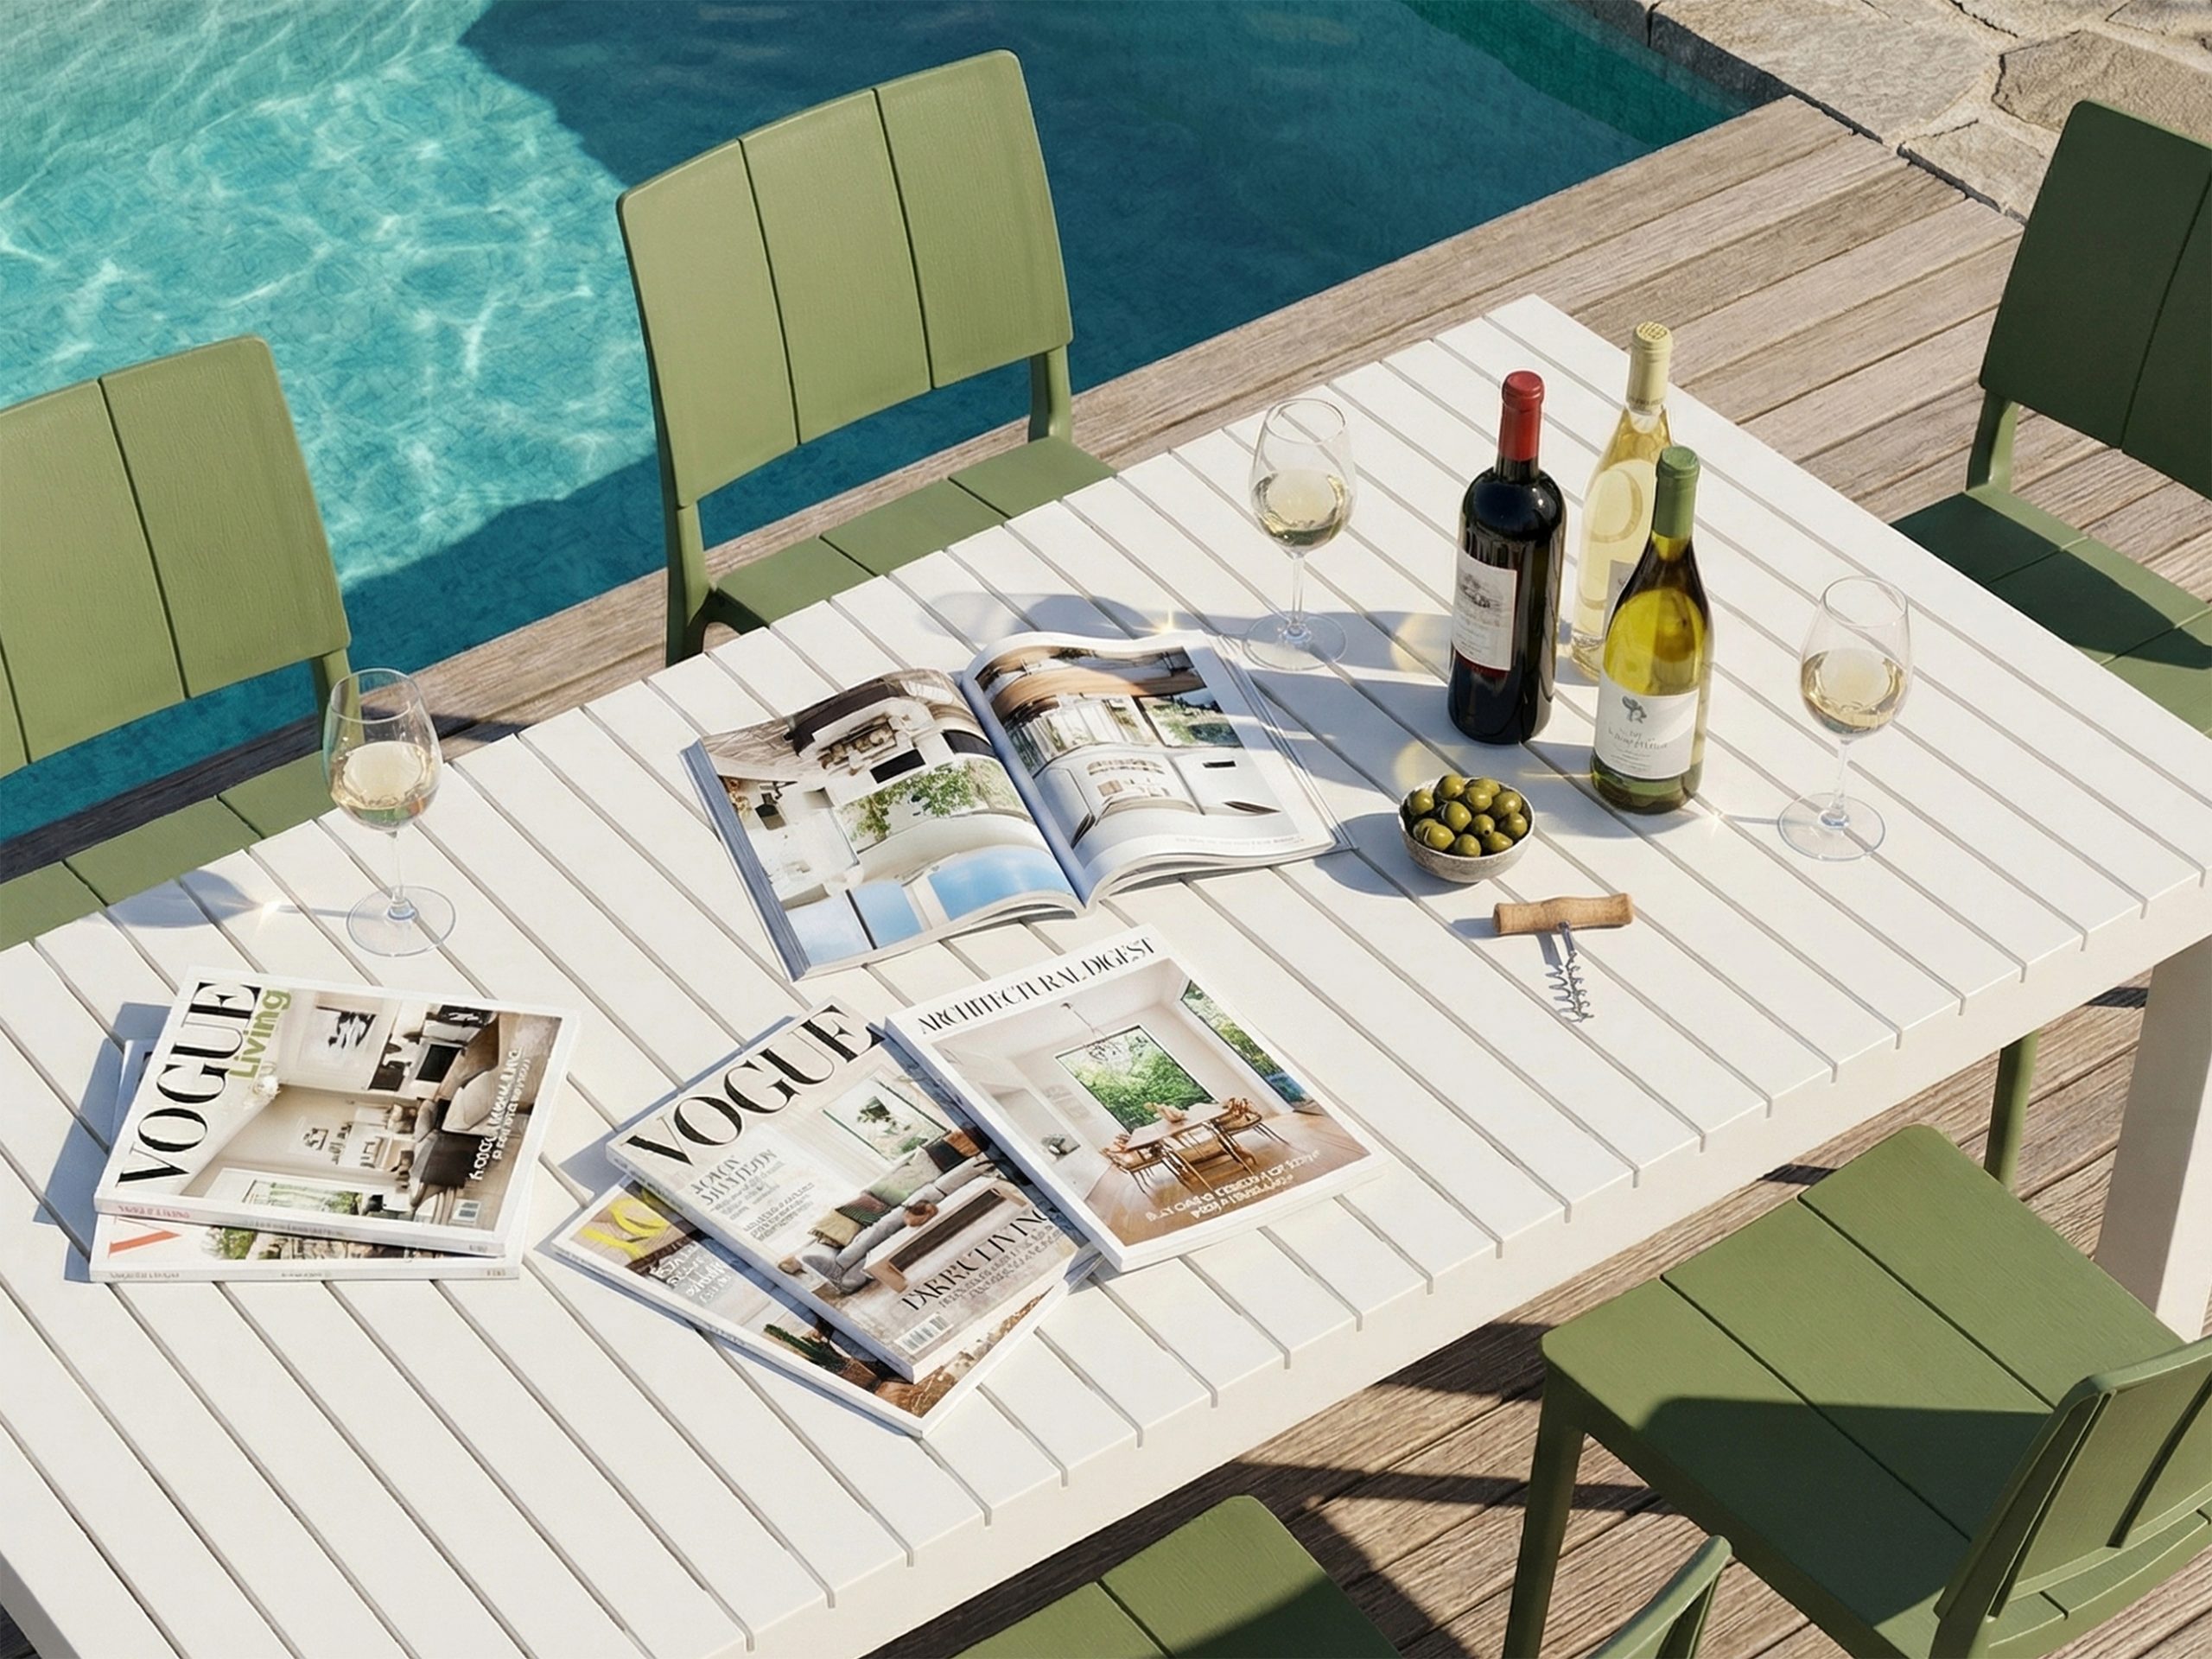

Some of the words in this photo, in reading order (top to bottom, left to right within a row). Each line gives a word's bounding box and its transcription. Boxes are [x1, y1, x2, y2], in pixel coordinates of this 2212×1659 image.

[228, 989, 292, 1078] Living
[918, 966, 1086, 1034] ARCHITECTURAL
[1081, 938, 1155, 977] DIGEST
[115, 982, 262, 1188] VOGUE
[620, 1004, 887, 1166] VOGUE
